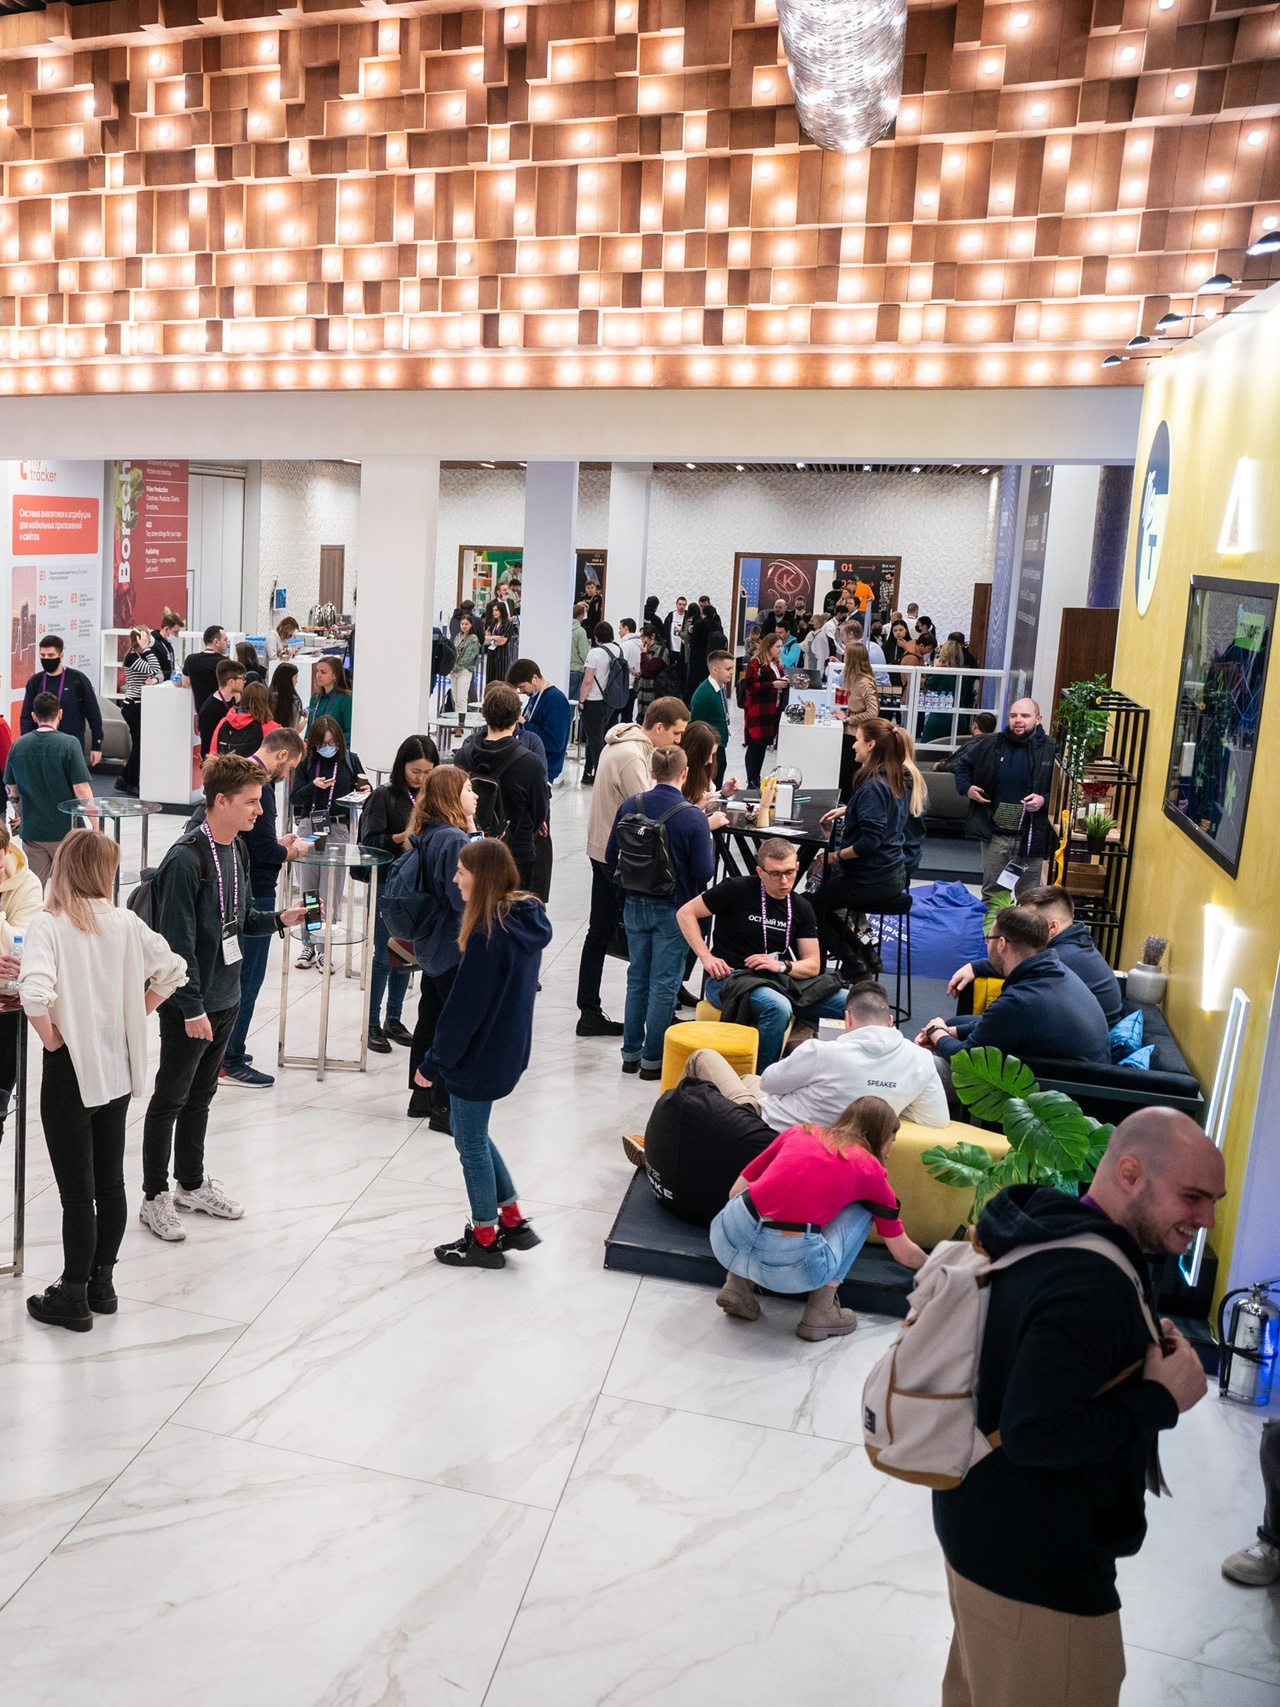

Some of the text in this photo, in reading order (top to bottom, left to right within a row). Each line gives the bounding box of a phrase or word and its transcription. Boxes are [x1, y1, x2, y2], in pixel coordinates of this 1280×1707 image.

[30, 467, 57, 482] tracker
[118, 461, 131, 583] Borsch
[841, 563, 853, 572] 01
[748, 914, 787, 928] ОСТЫЙ УМ
[867, 1079, 897, 1088] SPEAKER
